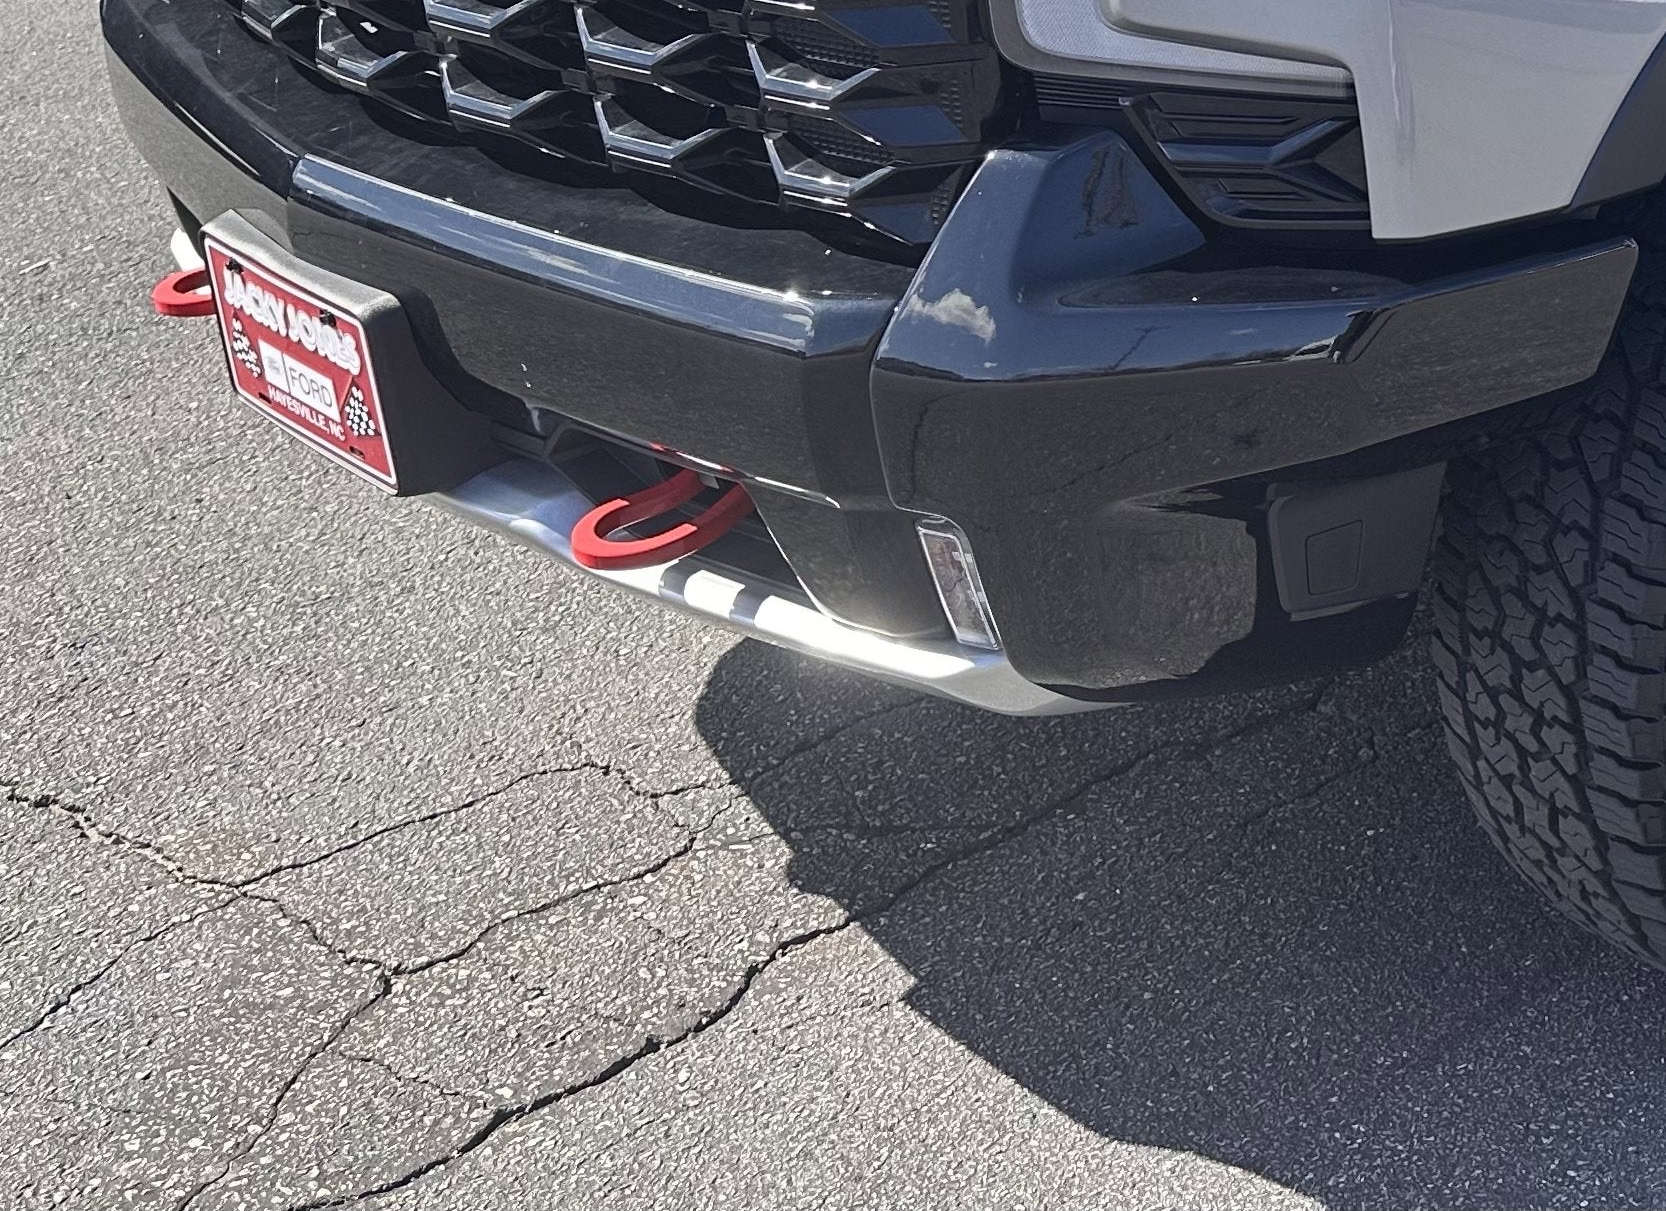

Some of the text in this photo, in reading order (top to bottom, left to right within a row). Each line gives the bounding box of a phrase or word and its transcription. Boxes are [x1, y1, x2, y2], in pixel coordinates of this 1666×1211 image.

[222, 266, 361, 376] JACKY JONES
[289, 366, 333, 407] FORD
[329, 417, 346, 442] NC
